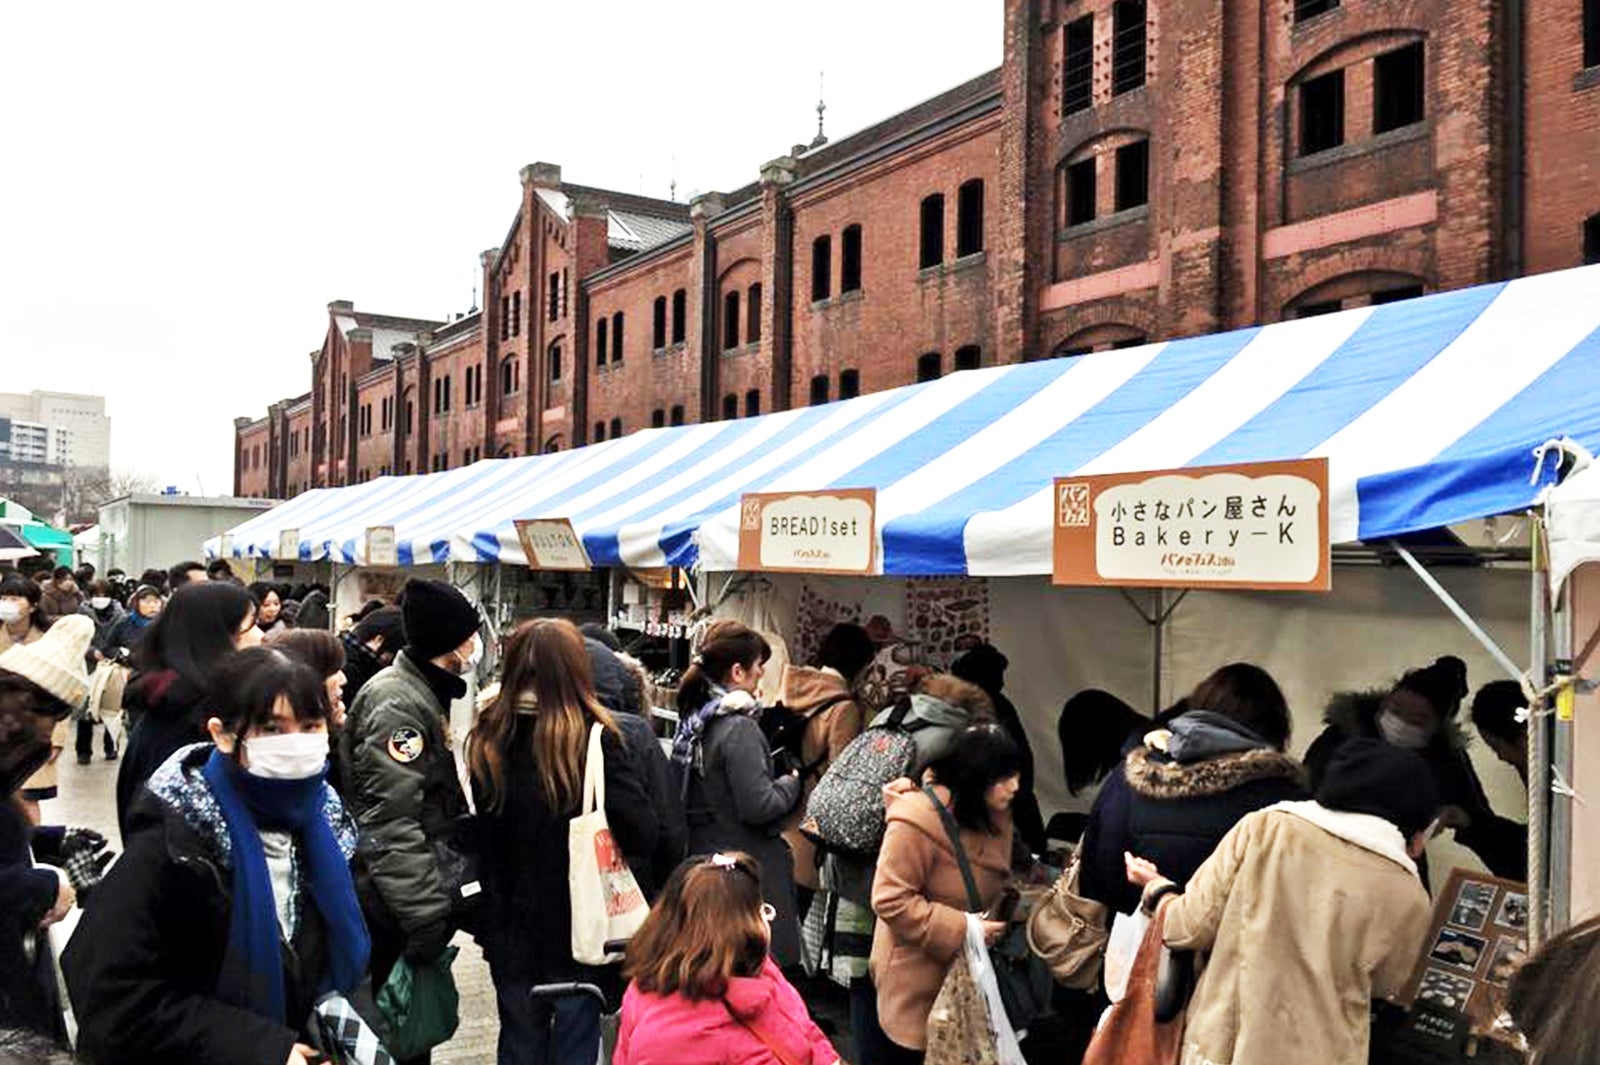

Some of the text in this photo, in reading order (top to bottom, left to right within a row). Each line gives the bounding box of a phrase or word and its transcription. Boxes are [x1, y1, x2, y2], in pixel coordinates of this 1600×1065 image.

[1111, 495, 1296, 522] 小さなパン屋さん
